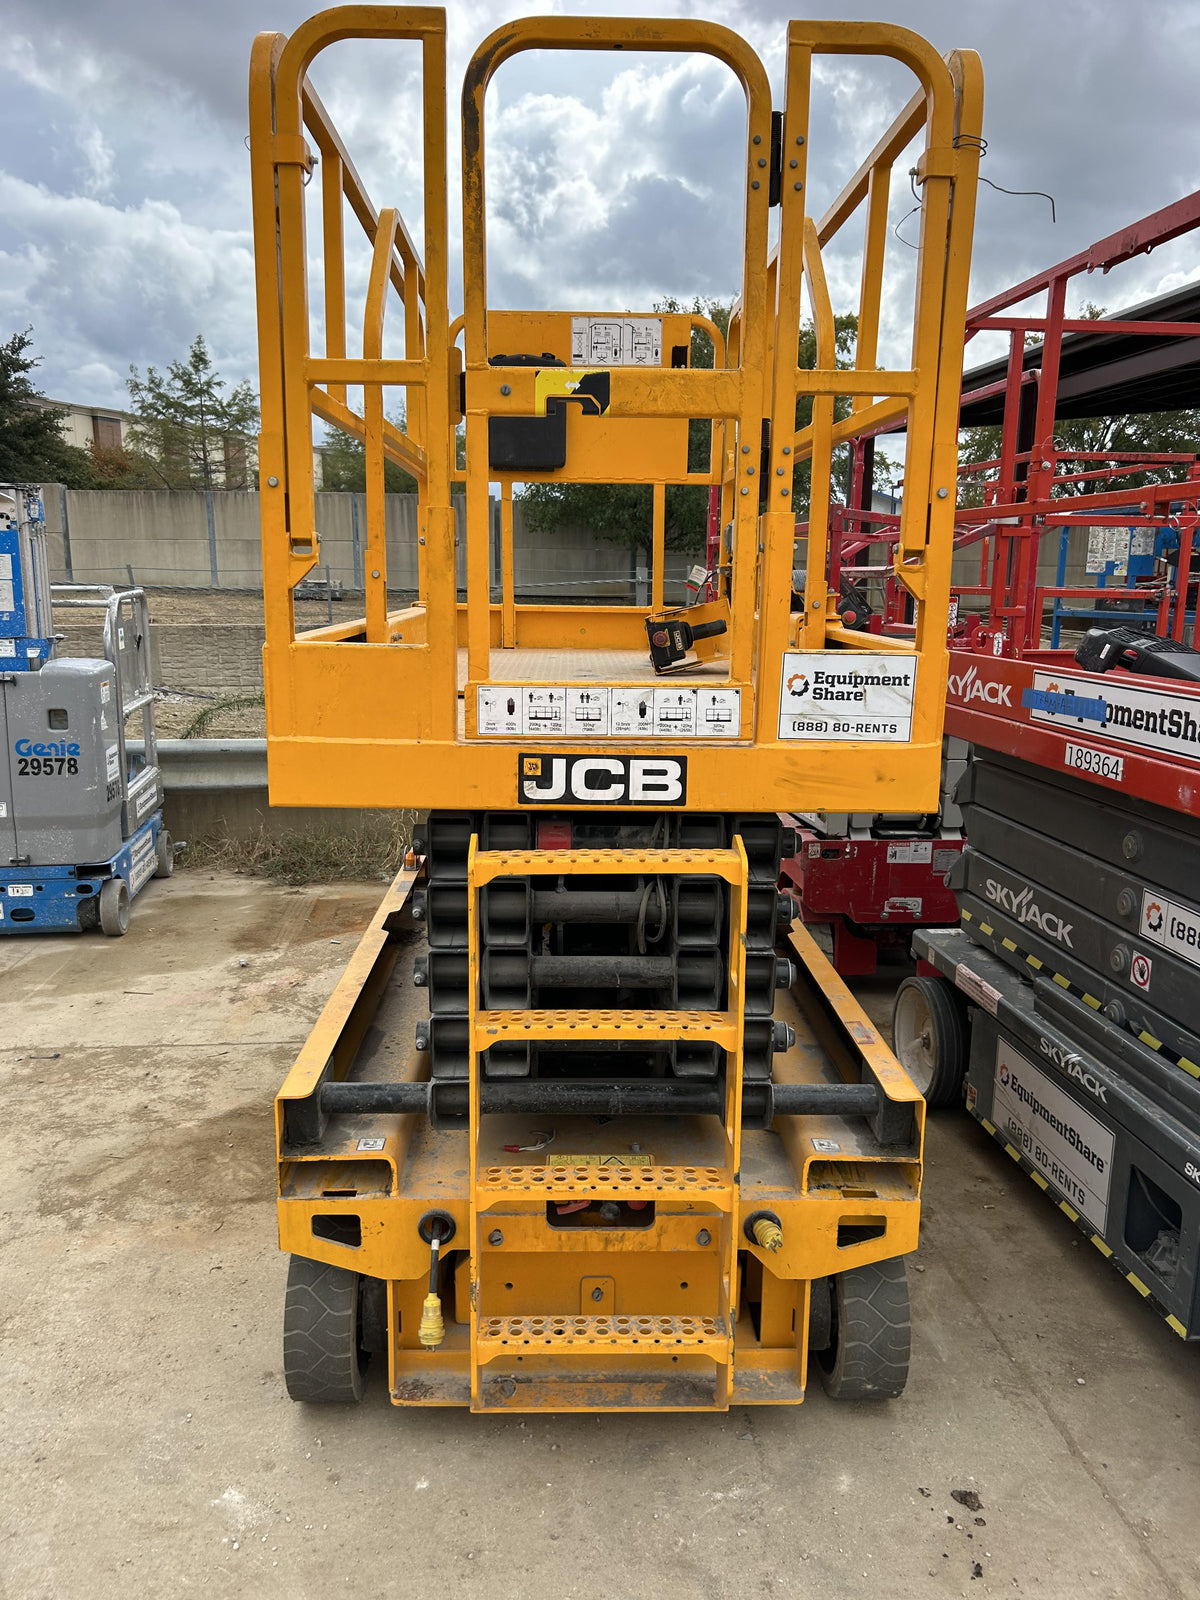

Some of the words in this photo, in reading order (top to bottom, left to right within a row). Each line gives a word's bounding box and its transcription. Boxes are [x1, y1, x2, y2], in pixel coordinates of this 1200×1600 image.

[812, 687, 864, 701] Share
[813, 671, 911, 688] Equipment
[947, 665, 1012, 707] KYJACK
[792, 720, 828, 732] (888)
[832, 723, 898, 733] 80-RENTS
[15, 738, 81, 757] Genie
[1068, 745, 1121, 780] 189364
[18, 758, 79, 776] 29578
[523, 757, 683, 801] JCB
[985, 878, 1074, 949] SKYJACK
[1039, 1037, 1108, 1104] SKYJACK
[1010, 1073, 1105, 1174] EquipmentShare
[1034, 1144, 1086, 1206] 80-RENTS
